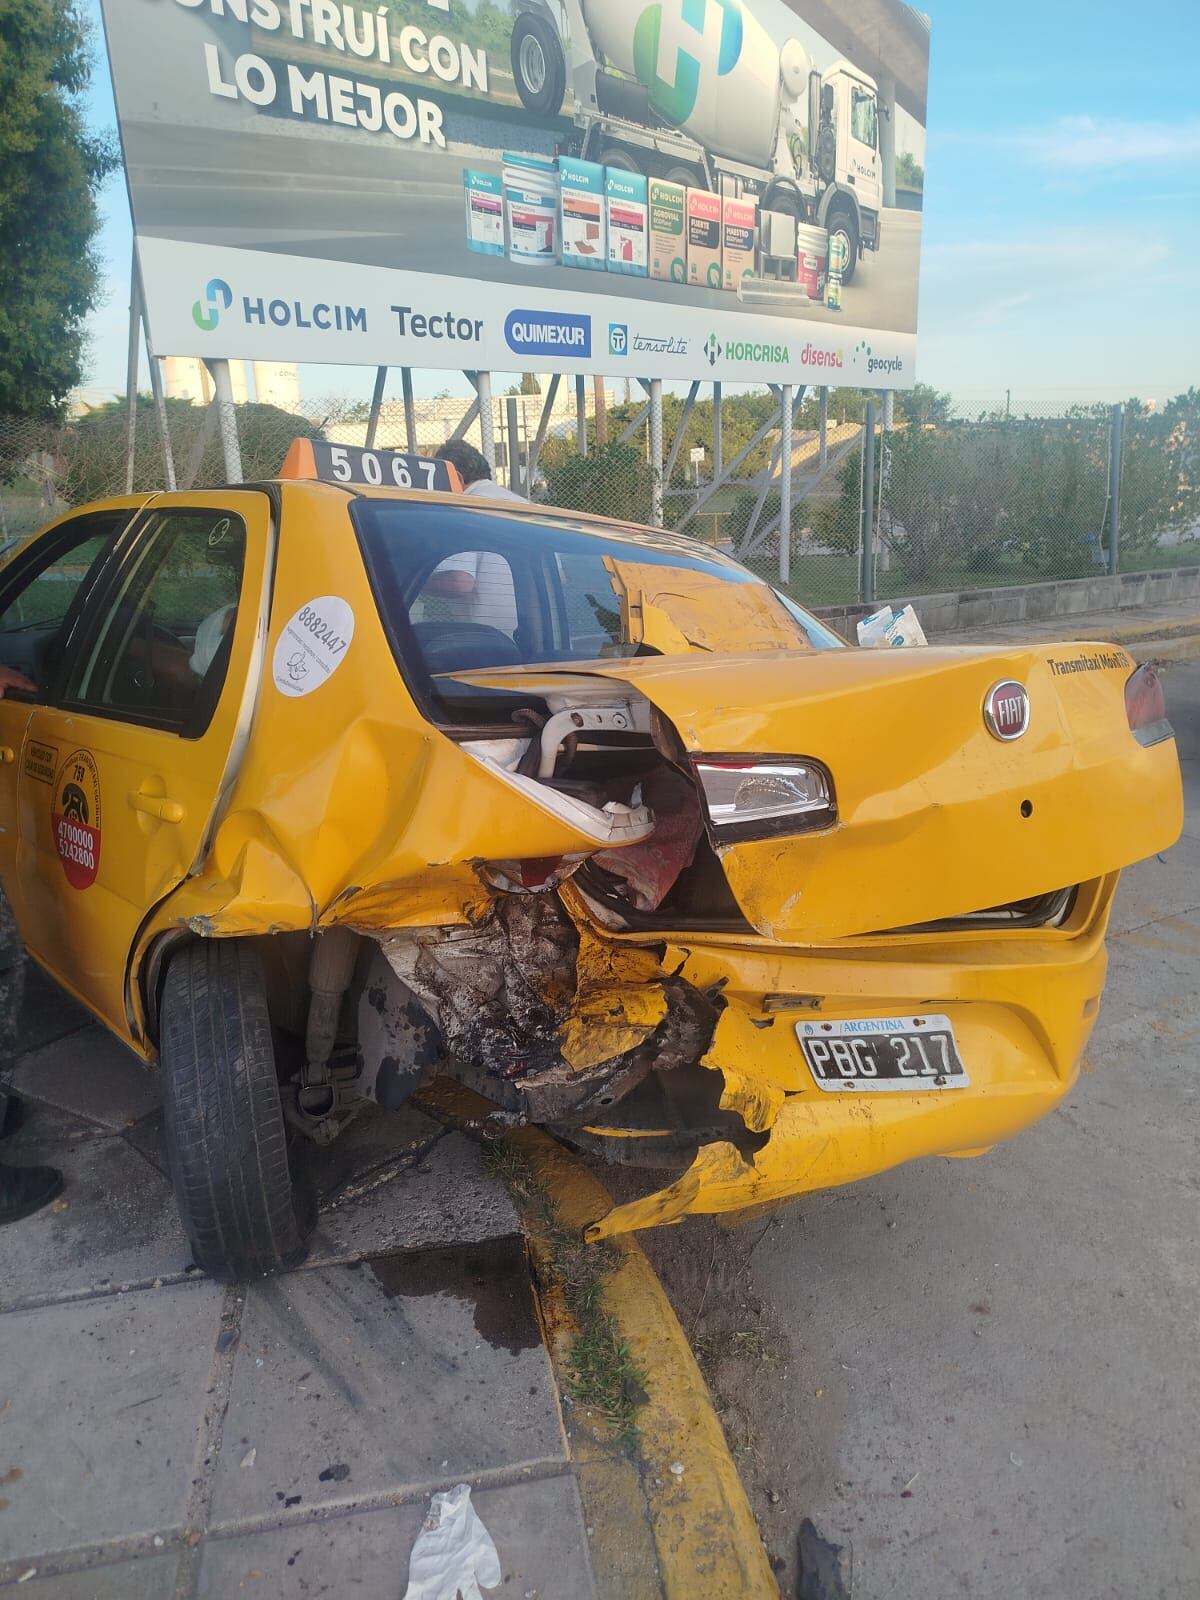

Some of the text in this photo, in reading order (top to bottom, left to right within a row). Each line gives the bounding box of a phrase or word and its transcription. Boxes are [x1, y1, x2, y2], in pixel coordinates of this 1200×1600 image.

[400, 26, 489, 92] CON
[204, 43, 446, 148] LO MEJOR
[568, 173, 590, 185] HOLCIM
[614, 183, 634, 195] HOLCIM
[660, 191, 682, 205] HOLCIM
[243, 296, 368, 333] HOLCIM
[391, 305, 483, 342] Tector
[512, 322, 585, 346] QUIMEXUR
[633, 333, 688, 355] tensolite
[725, 341, 789, 364] HORCRISA
[868, 355, 903, 374] geocycle
[330, 447, 436, 491] 5067
[298, 606, 347, 655] 8882447
[1047, 653, 1102, 676] Transmitaxi
[997, 695, 1023, 726] FIAT
[58, 821, 94, 850] 4700000
[59, 839, 95, 870] 5242800
[844, 1020, 905, 1033] ARGENTINA
[808, 1035, 951, 1078] PBG 217
